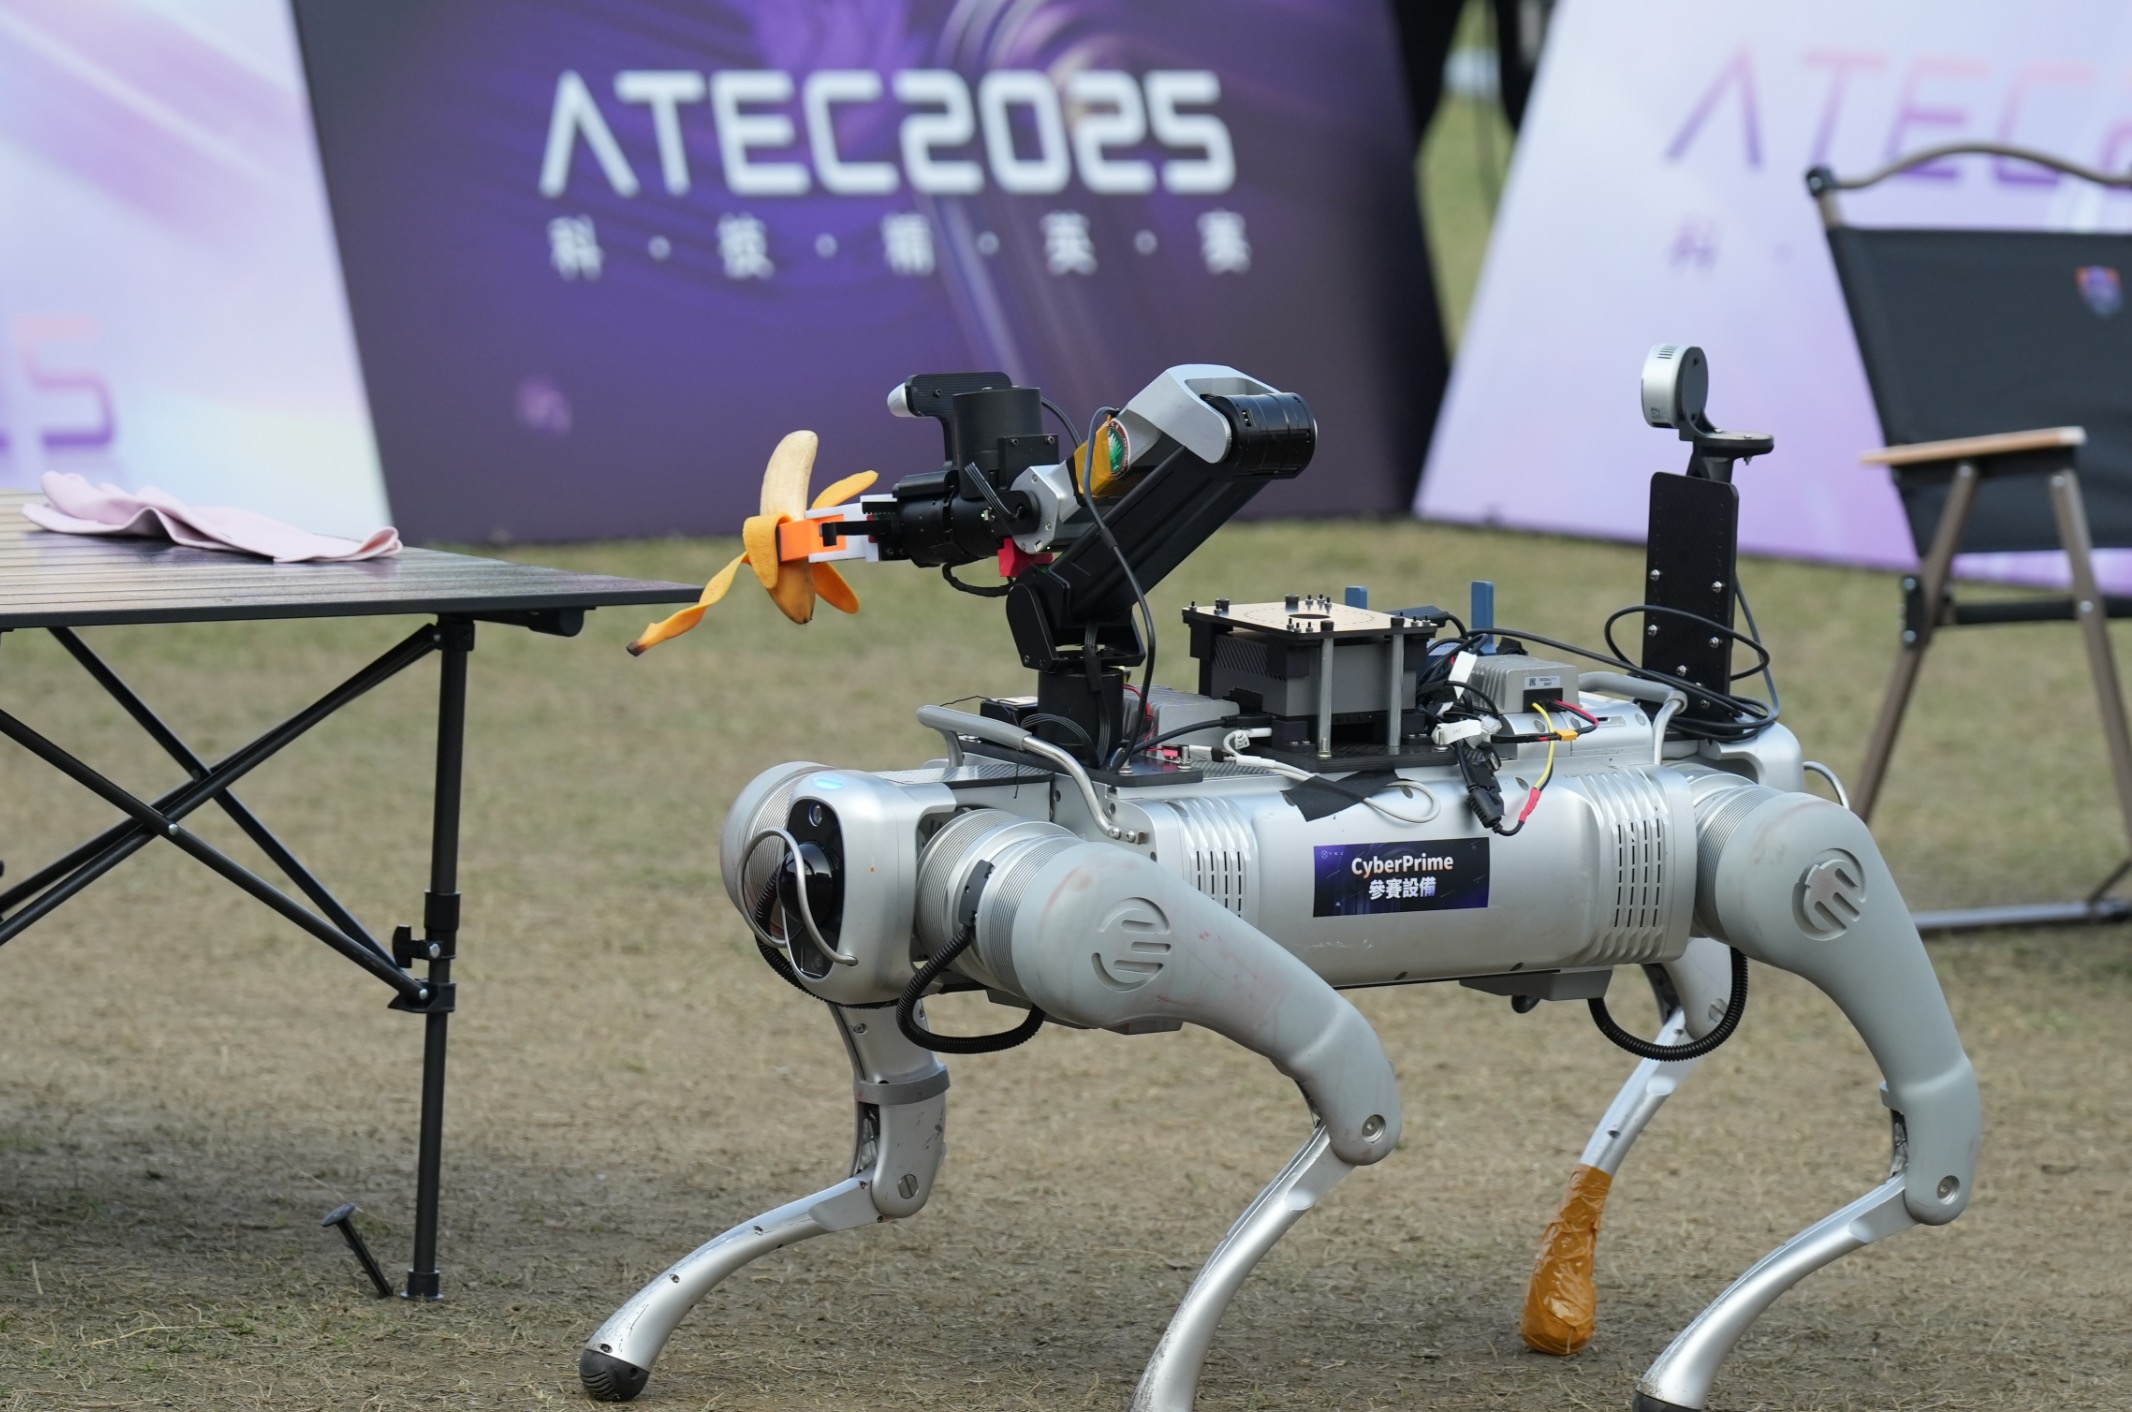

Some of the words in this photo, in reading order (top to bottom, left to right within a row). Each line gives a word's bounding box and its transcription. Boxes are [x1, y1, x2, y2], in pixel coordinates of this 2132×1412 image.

[539, 69, 1236, 198] ATEC2025
[0, 315, 115, 452] 5
[1351, 853, 1454, 878] CyberPrime
[1368, 876, 1437, 900] 參賽設備
